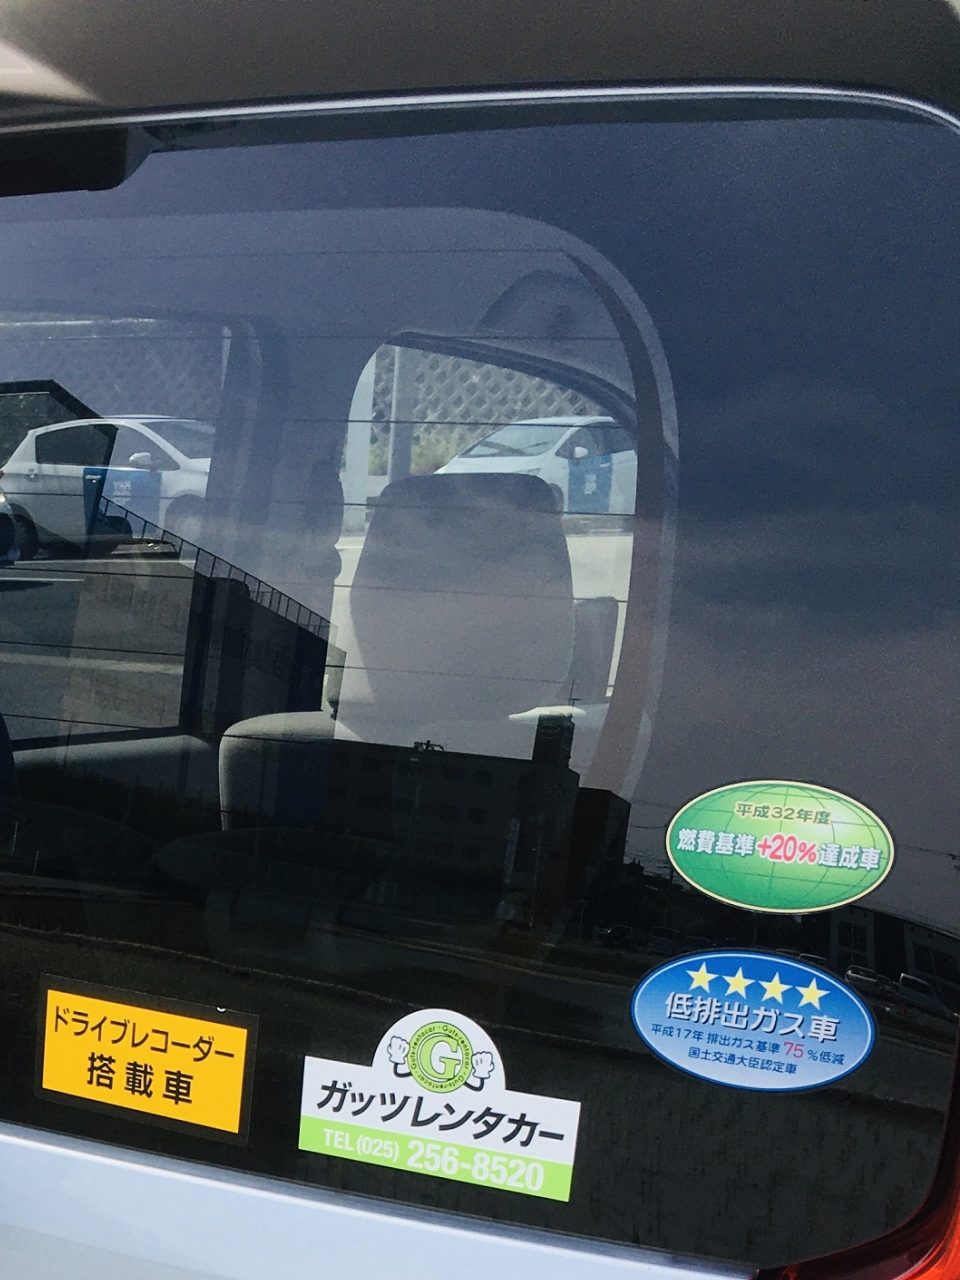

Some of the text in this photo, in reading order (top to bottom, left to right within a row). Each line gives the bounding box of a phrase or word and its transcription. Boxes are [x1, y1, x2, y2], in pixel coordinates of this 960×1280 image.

[735, 802, 832, 825] 平成32年度
[54, 1005, 235, 1063] ドライブレコーダー
[665, 991, 841, 1043] 低排出ガス車
[87, 1052, 194, 1105] 搭載車
[420, 1035, 461, 1079] G
[688, 1046, 797, 1075] 国土交通大臣認定車
[316, 1080, 565, 1147] ガッツレンタカー
[323, 1128, 544, 1192] TEL (025) 256-8520
